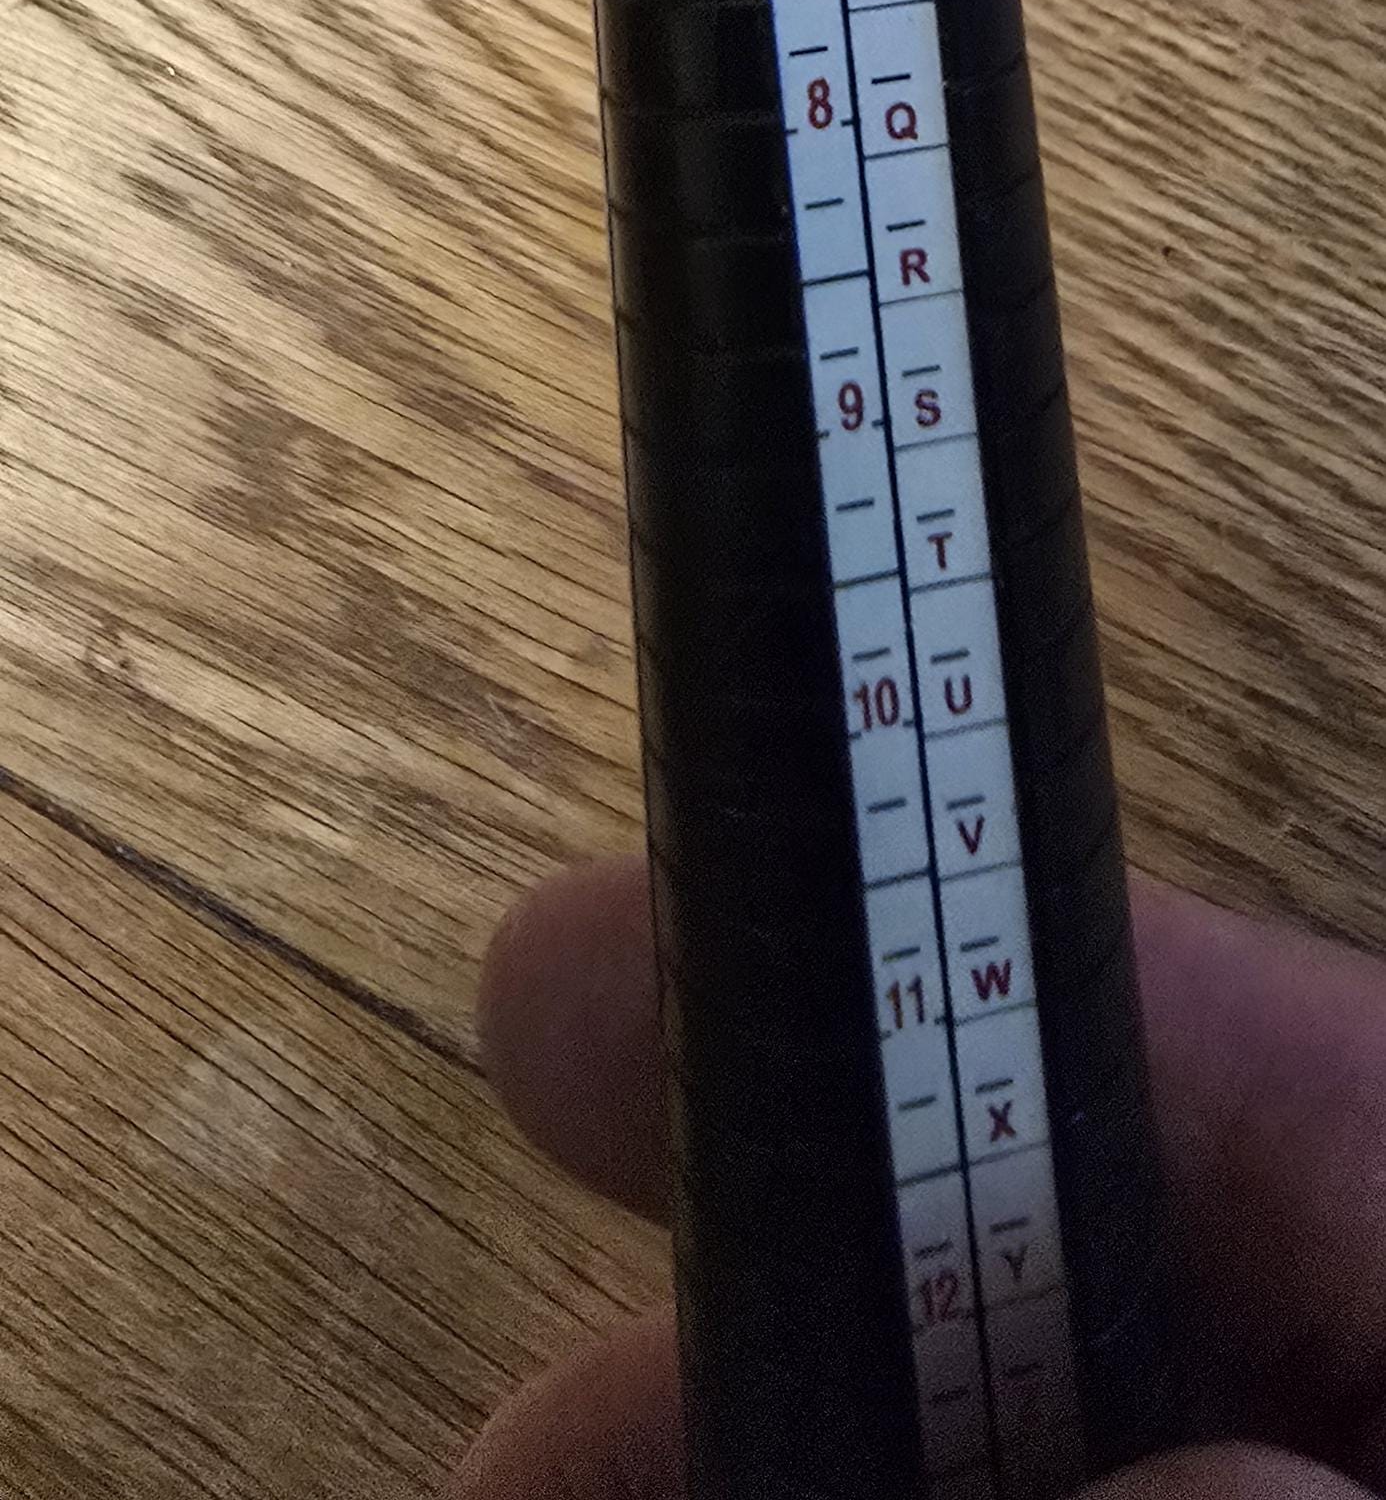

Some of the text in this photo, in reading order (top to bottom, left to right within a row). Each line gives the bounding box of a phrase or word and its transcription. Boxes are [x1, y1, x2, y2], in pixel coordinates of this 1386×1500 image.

[807, 77, 833, 129] 8
[885, 102, 919, 141] Q
[900, 247, 931, 286] R
[838, 381, 864, 431] 9
[915, 389, 942, 427] S
[927, 531, 953, 569] T
[854, 677, 899, 730] 10
[944, 674, 973, 716] U
[957, 814, 986, 855] V
[971, 959, 1013, 1001] W
[886, 975, 926, 1030] 11
[989, 1101, 1016, 1142] X
[1001, 1243, 1029, 1281] Y
[919, 1269, 959, 1326] 12
